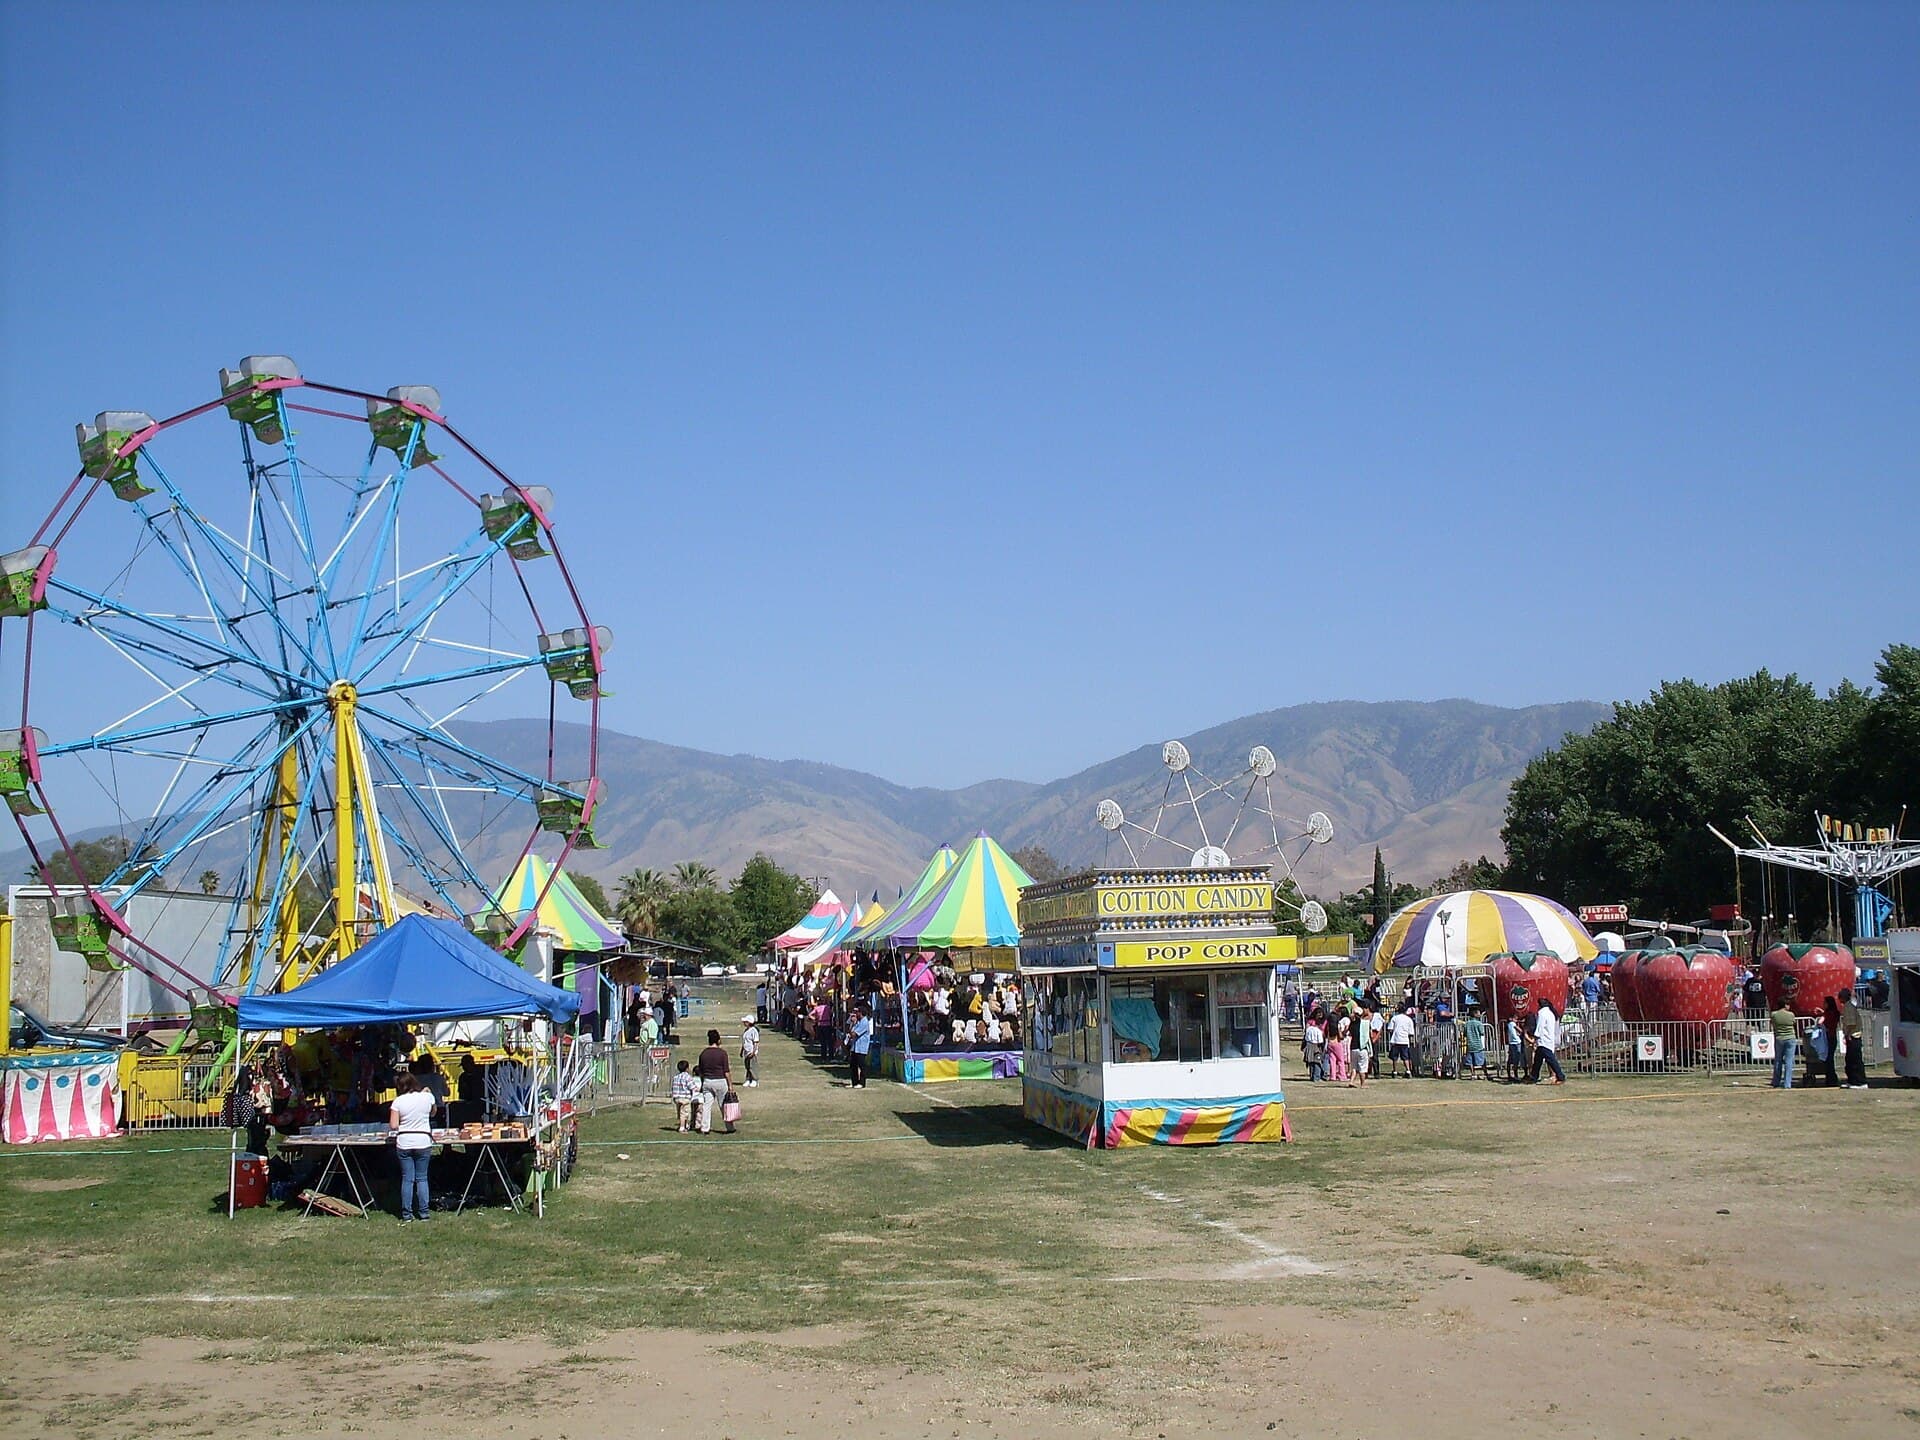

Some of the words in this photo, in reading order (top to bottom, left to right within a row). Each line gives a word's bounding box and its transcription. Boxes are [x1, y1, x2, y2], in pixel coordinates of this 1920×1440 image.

[1102, 890, 1185, 912] COTTON
[1197, 887, 1267, 909] CANDY
[1147, 946, 1192, 961] POP
[1203, 943, 1267, 958] CORN
